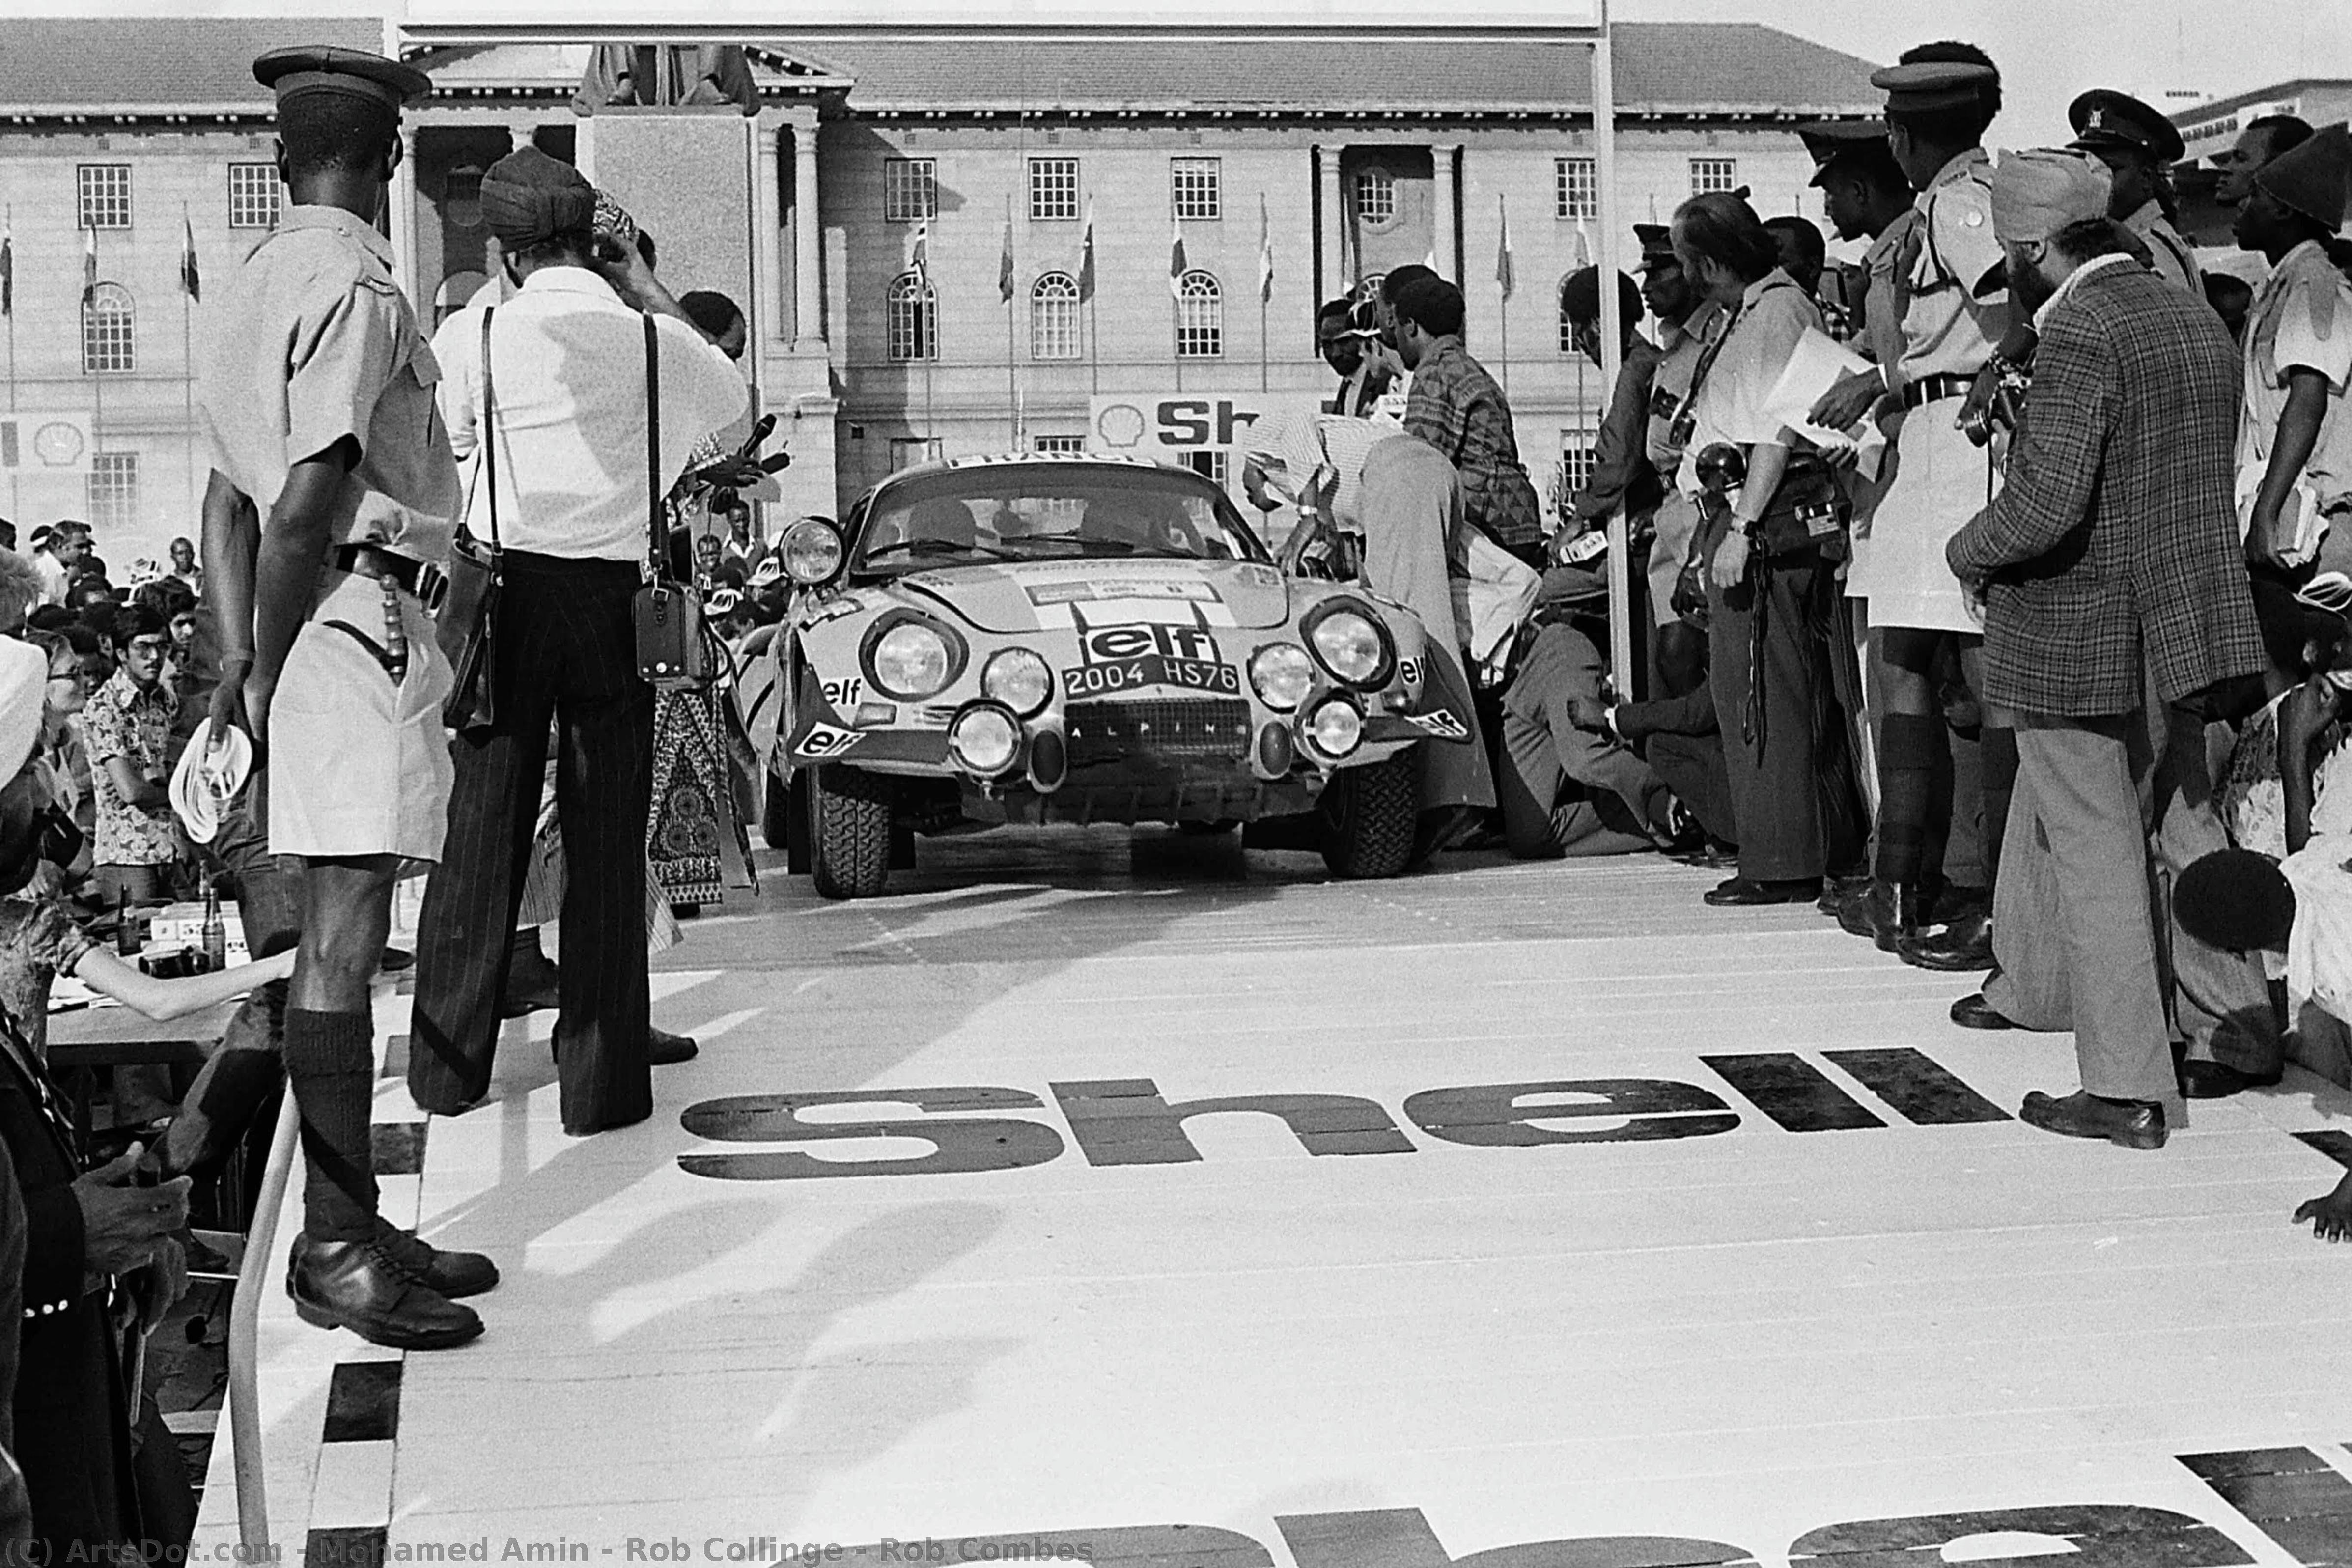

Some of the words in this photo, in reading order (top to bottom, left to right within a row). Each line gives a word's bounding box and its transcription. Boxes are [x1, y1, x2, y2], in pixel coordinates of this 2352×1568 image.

[1091, 623, 1206, 658] elf
[823, 677, 861, 705] elf
[1065, 663, 1144, 694] 2004
[1163, 660, 1237, 689] HS76
[803, 731, 860, 754] elf
[677, 1047, 2015, 1180] Shell
